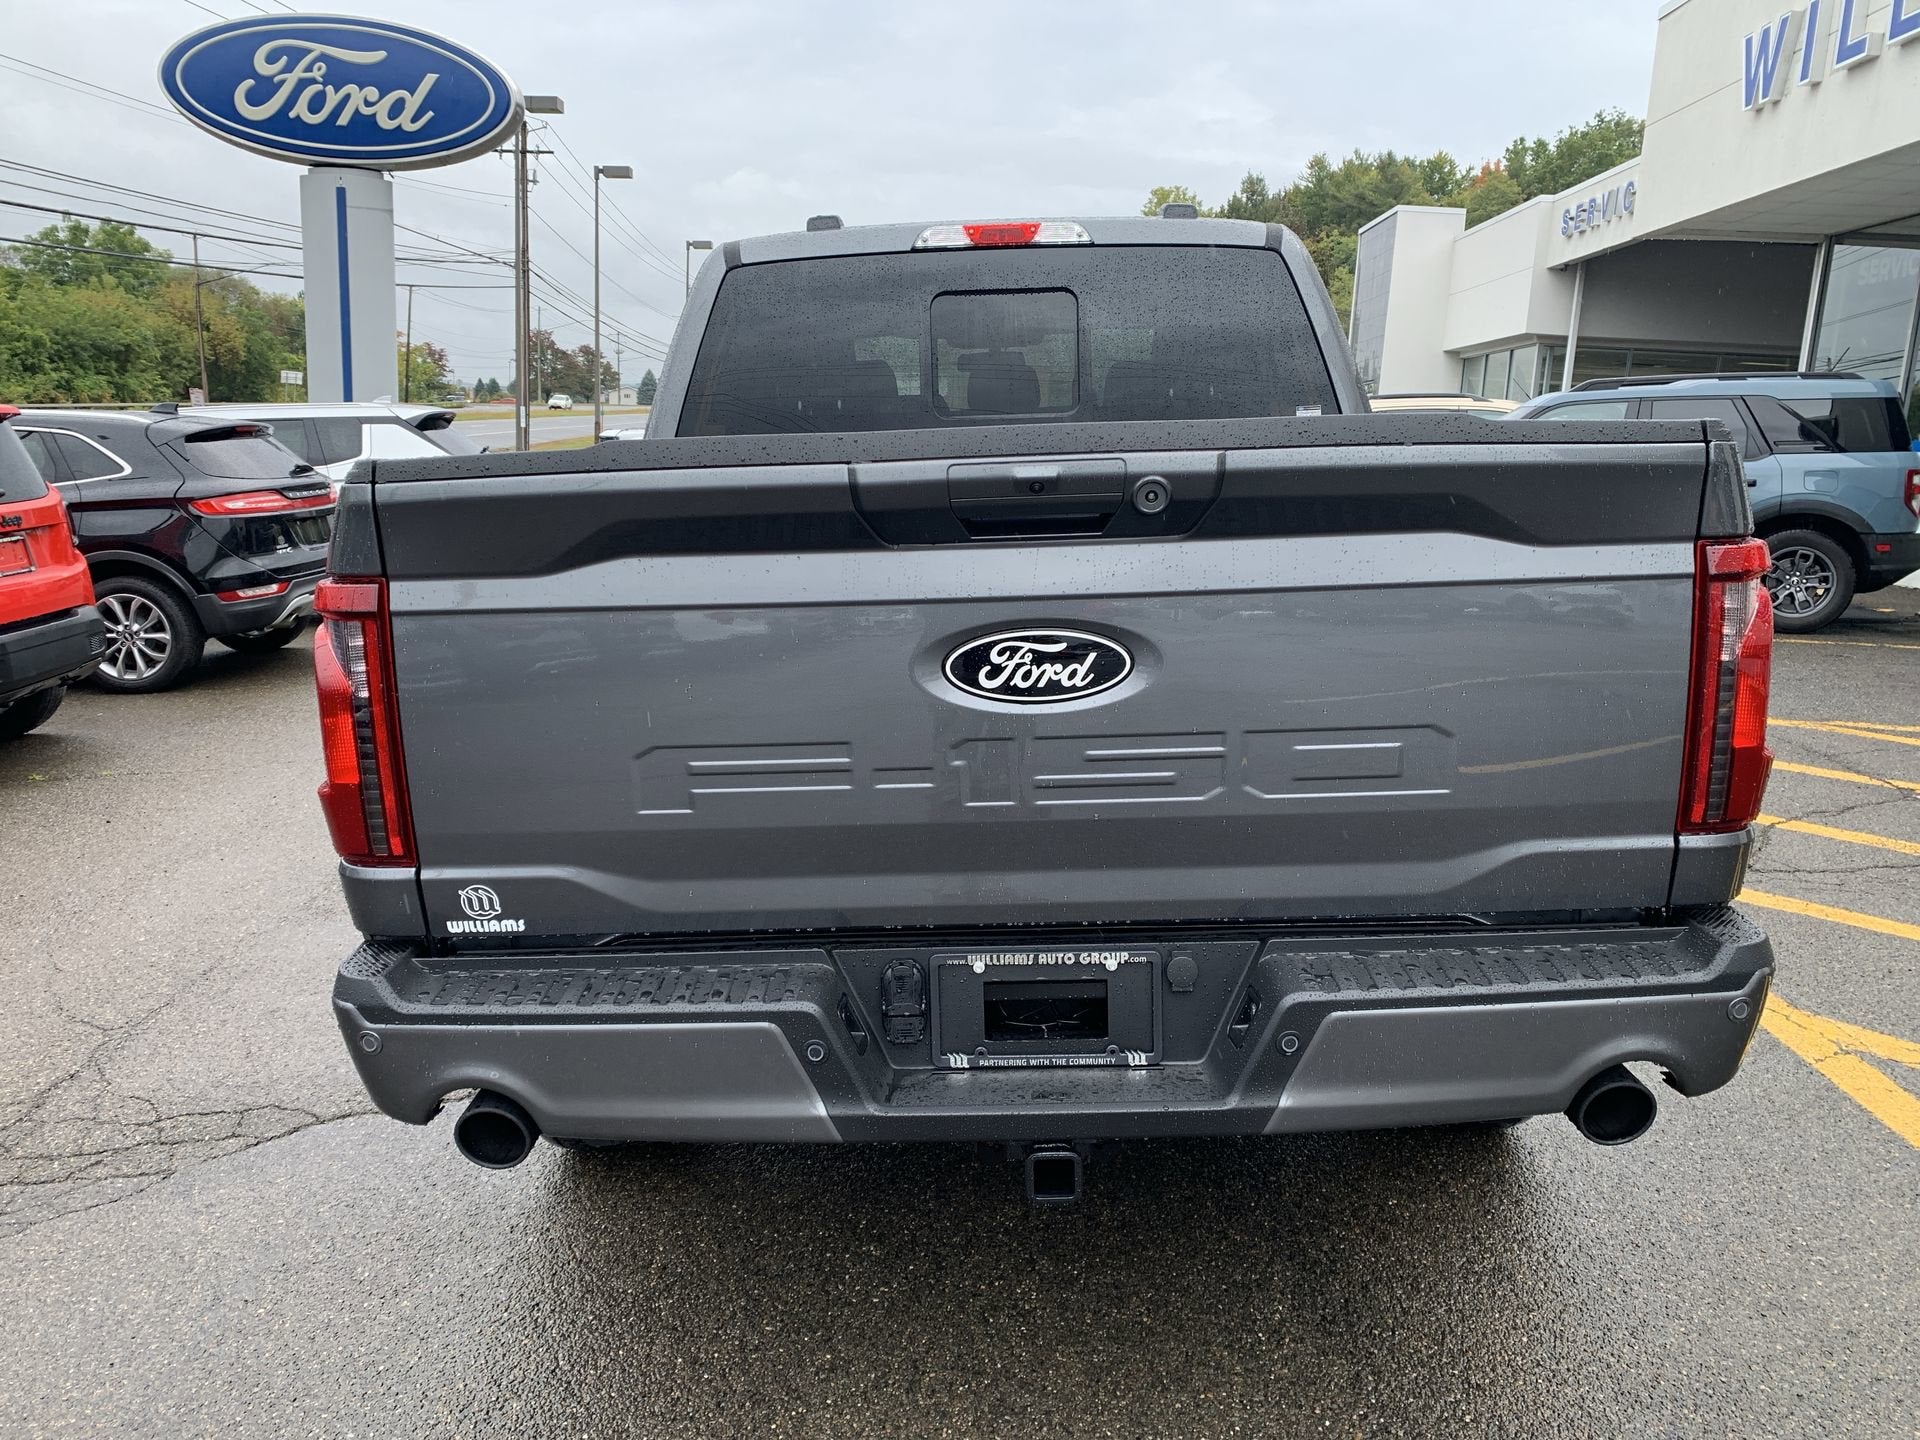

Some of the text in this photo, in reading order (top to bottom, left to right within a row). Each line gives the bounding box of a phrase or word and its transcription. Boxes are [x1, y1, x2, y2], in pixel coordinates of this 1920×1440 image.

[234, 39, 438, 132] Ford
[1561, 180, 1637, 238] SERVIC
[979, 641, 1098, 690] Ford
[634, 725, 1456, 815] F-150
[446, 919, 526, 934] WILLIAMS
[1038, 953, 1076, 965] AUTO
[979, 1059, 1027, 1067] PARTNERING
[1029, 1058, 1050, 1066] WITH
[1069, 1057, 1116, 1065] COMMUNITY
